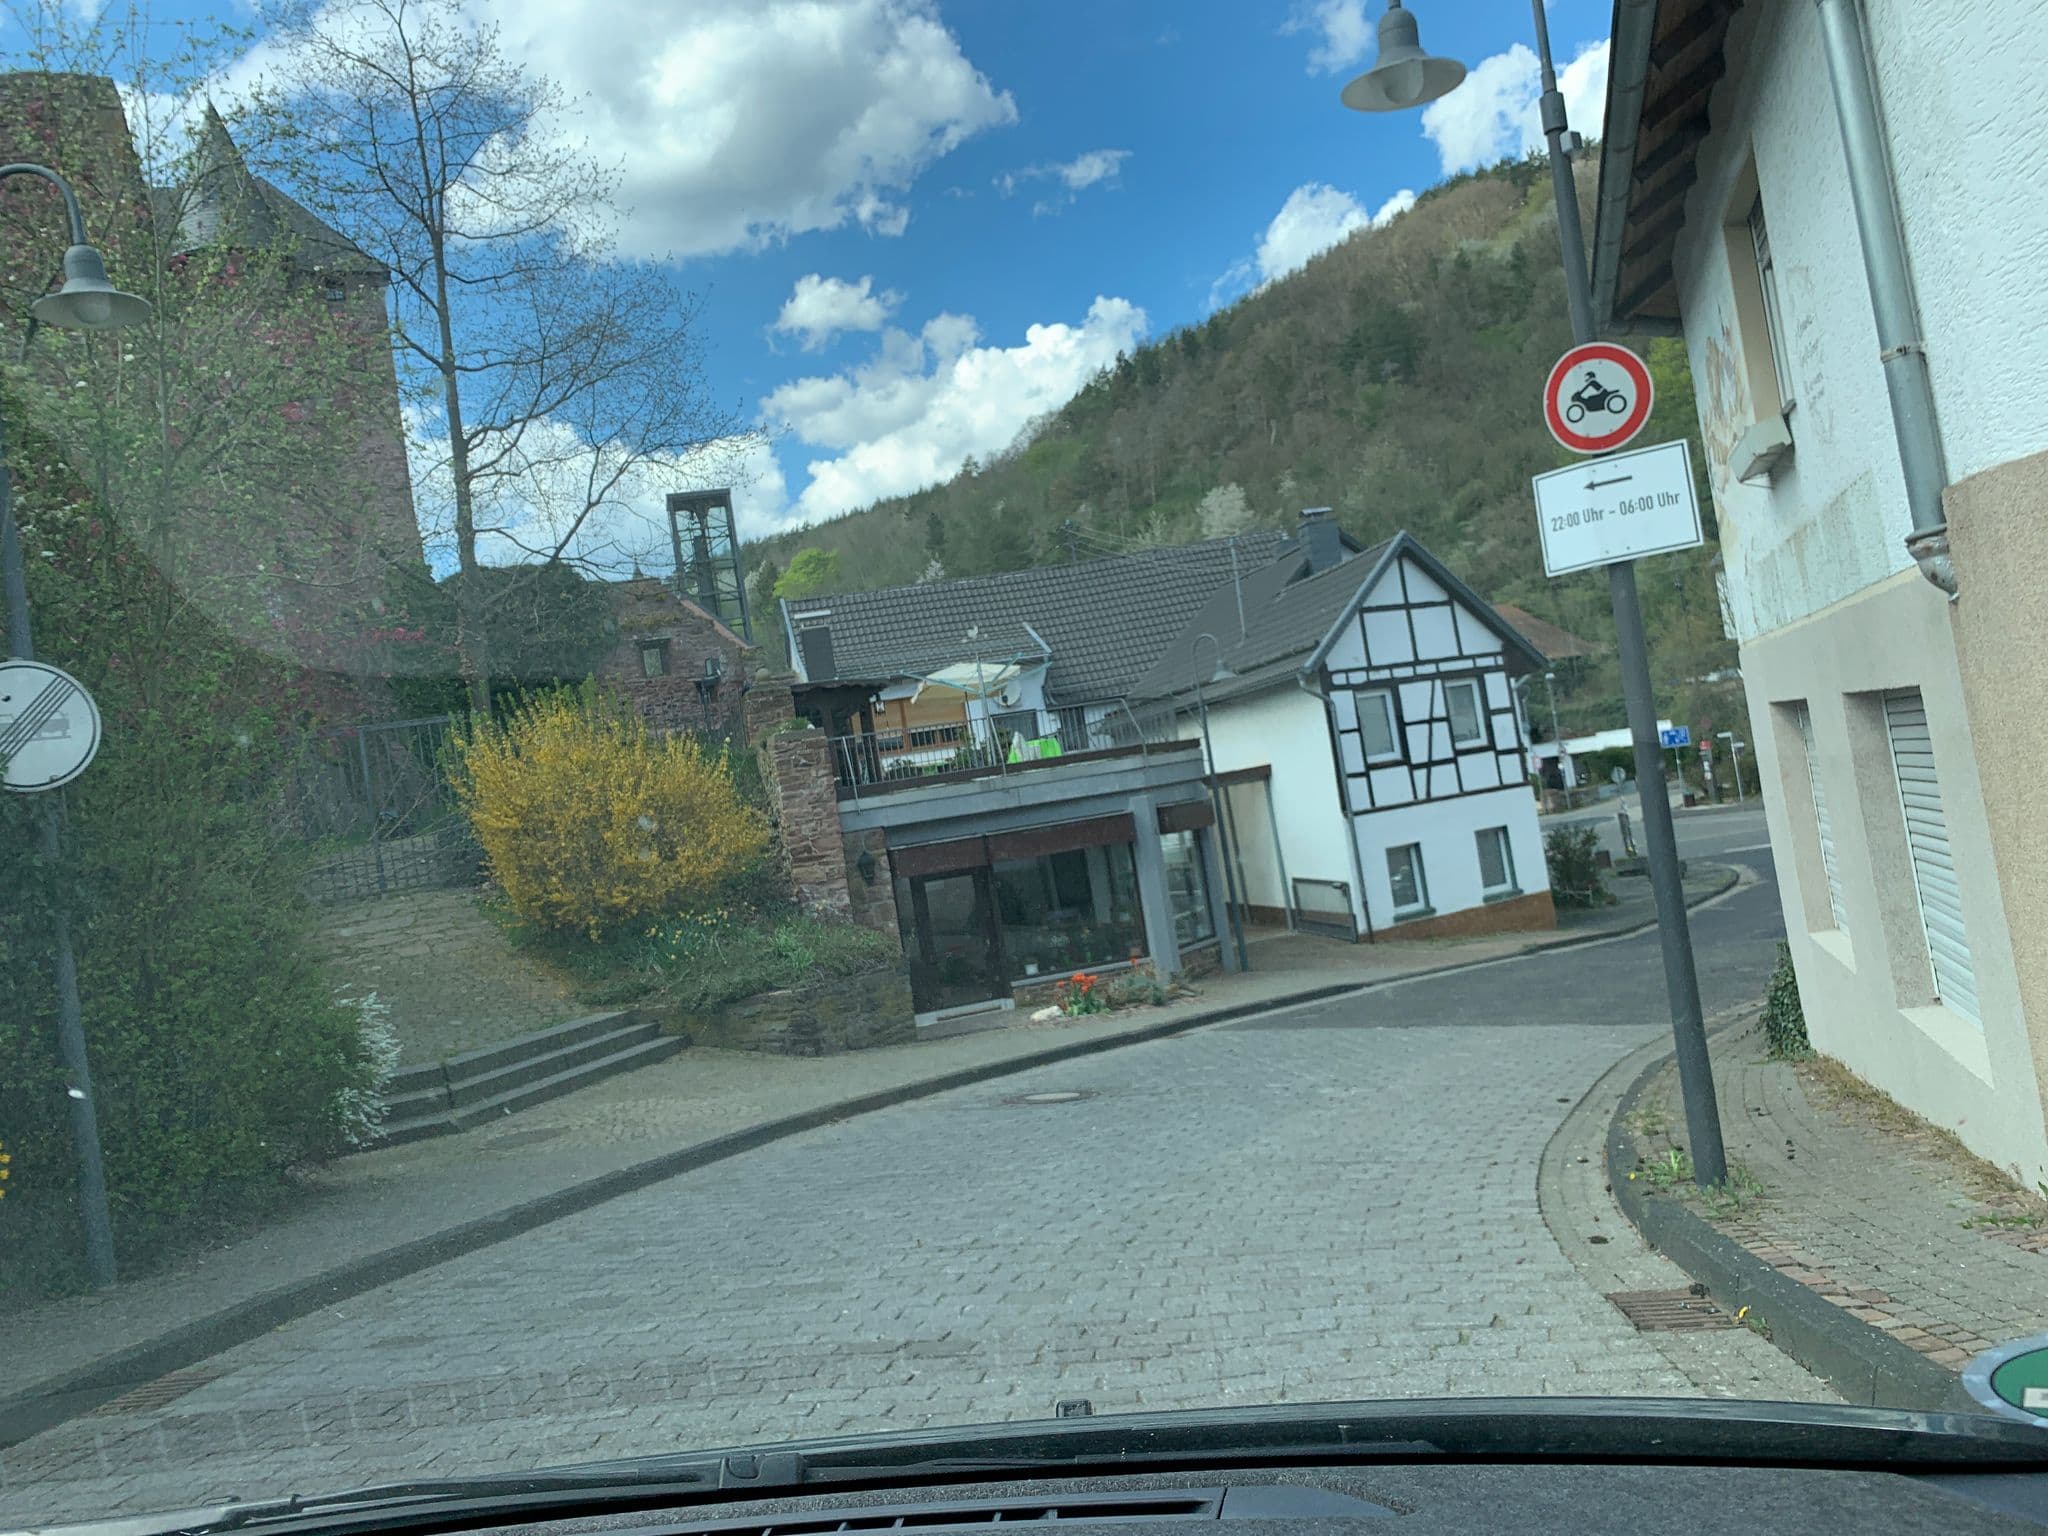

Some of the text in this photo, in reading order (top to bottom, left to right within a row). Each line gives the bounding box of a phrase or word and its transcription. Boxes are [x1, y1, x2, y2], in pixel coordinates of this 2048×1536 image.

[1551, 512, 1580, 532] 22:00
[1582, 508, 1604, 523] Uhr
[1619, 495, 1654, 515] 06:00
[1657, 491, 1680, 507] Uhr
